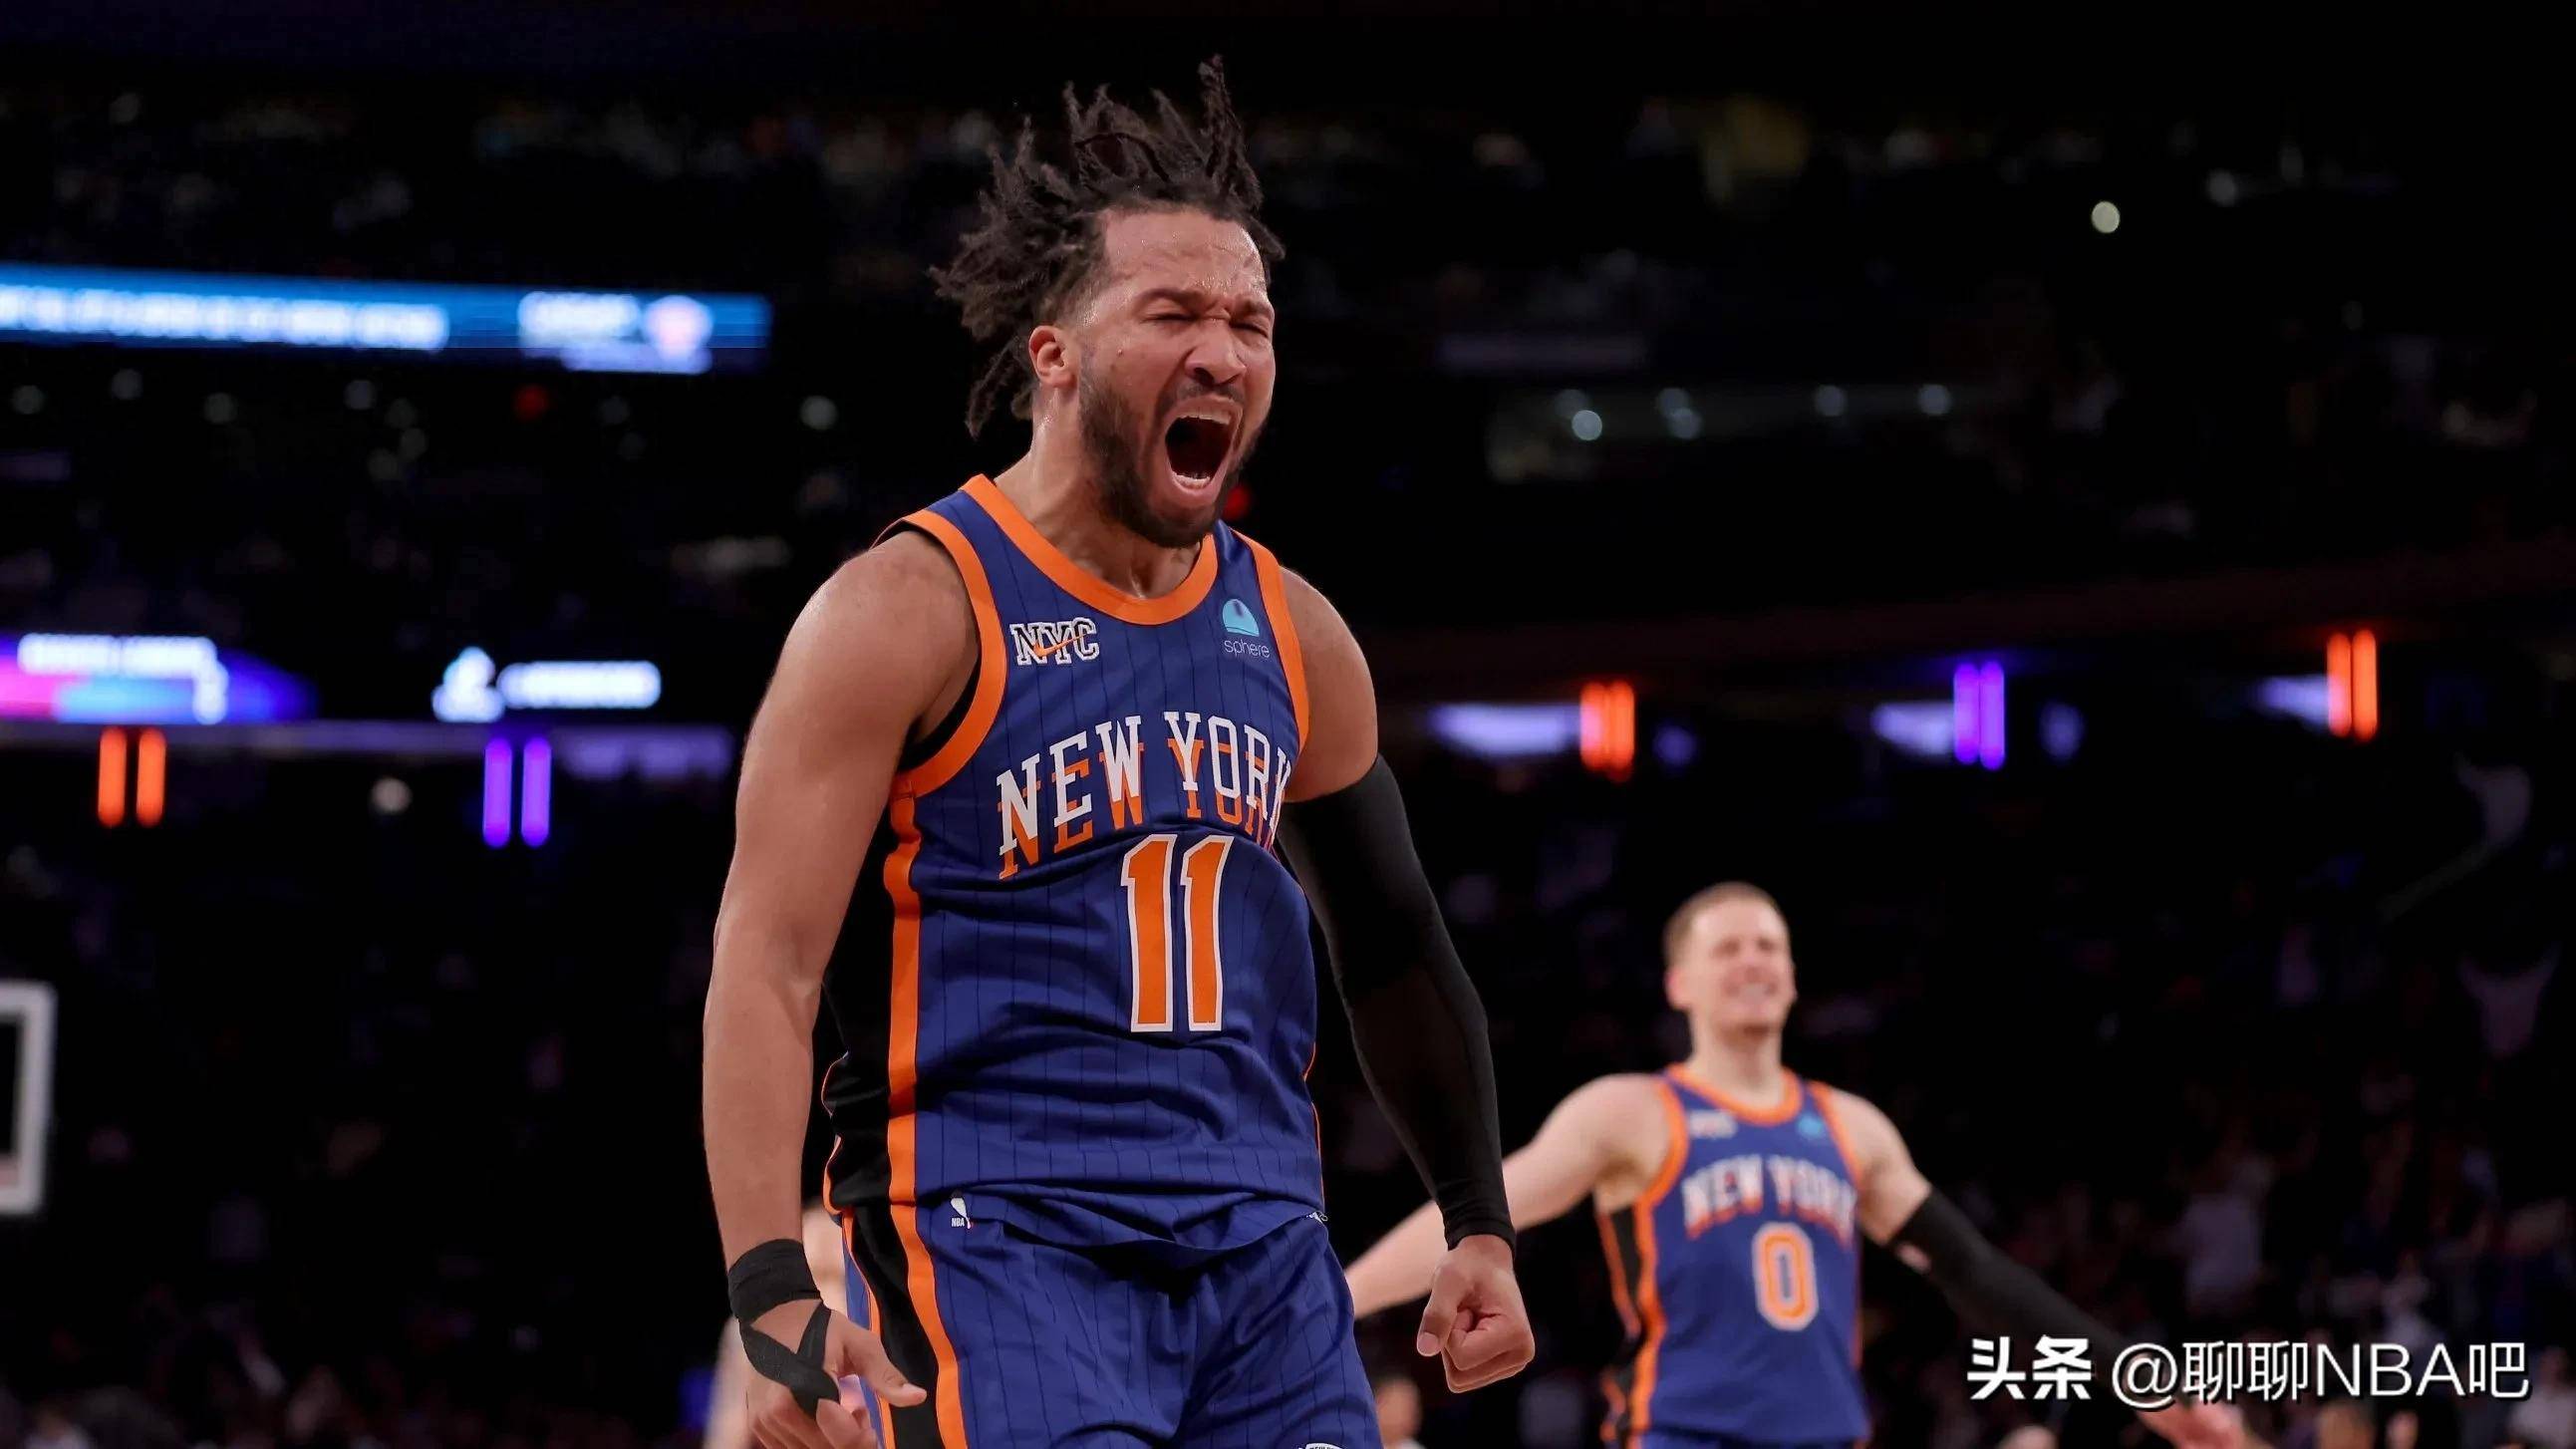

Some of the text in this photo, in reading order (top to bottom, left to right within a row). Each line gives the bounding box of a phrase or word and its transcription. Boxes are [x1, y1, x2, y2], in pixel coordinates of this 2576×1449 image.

[1009, 617, 1100, 666] NYC
[1224, 638, 1270, 658] sphere
[997, 712, 1291, 879] NEW YORK
[1120, 834, 1235, 1032] 11
[951, 1217, 966, 1228] NBA
[1682, 1154, 1763, 1238] NEW
[1752, 1221, 1820, 1332] 0
